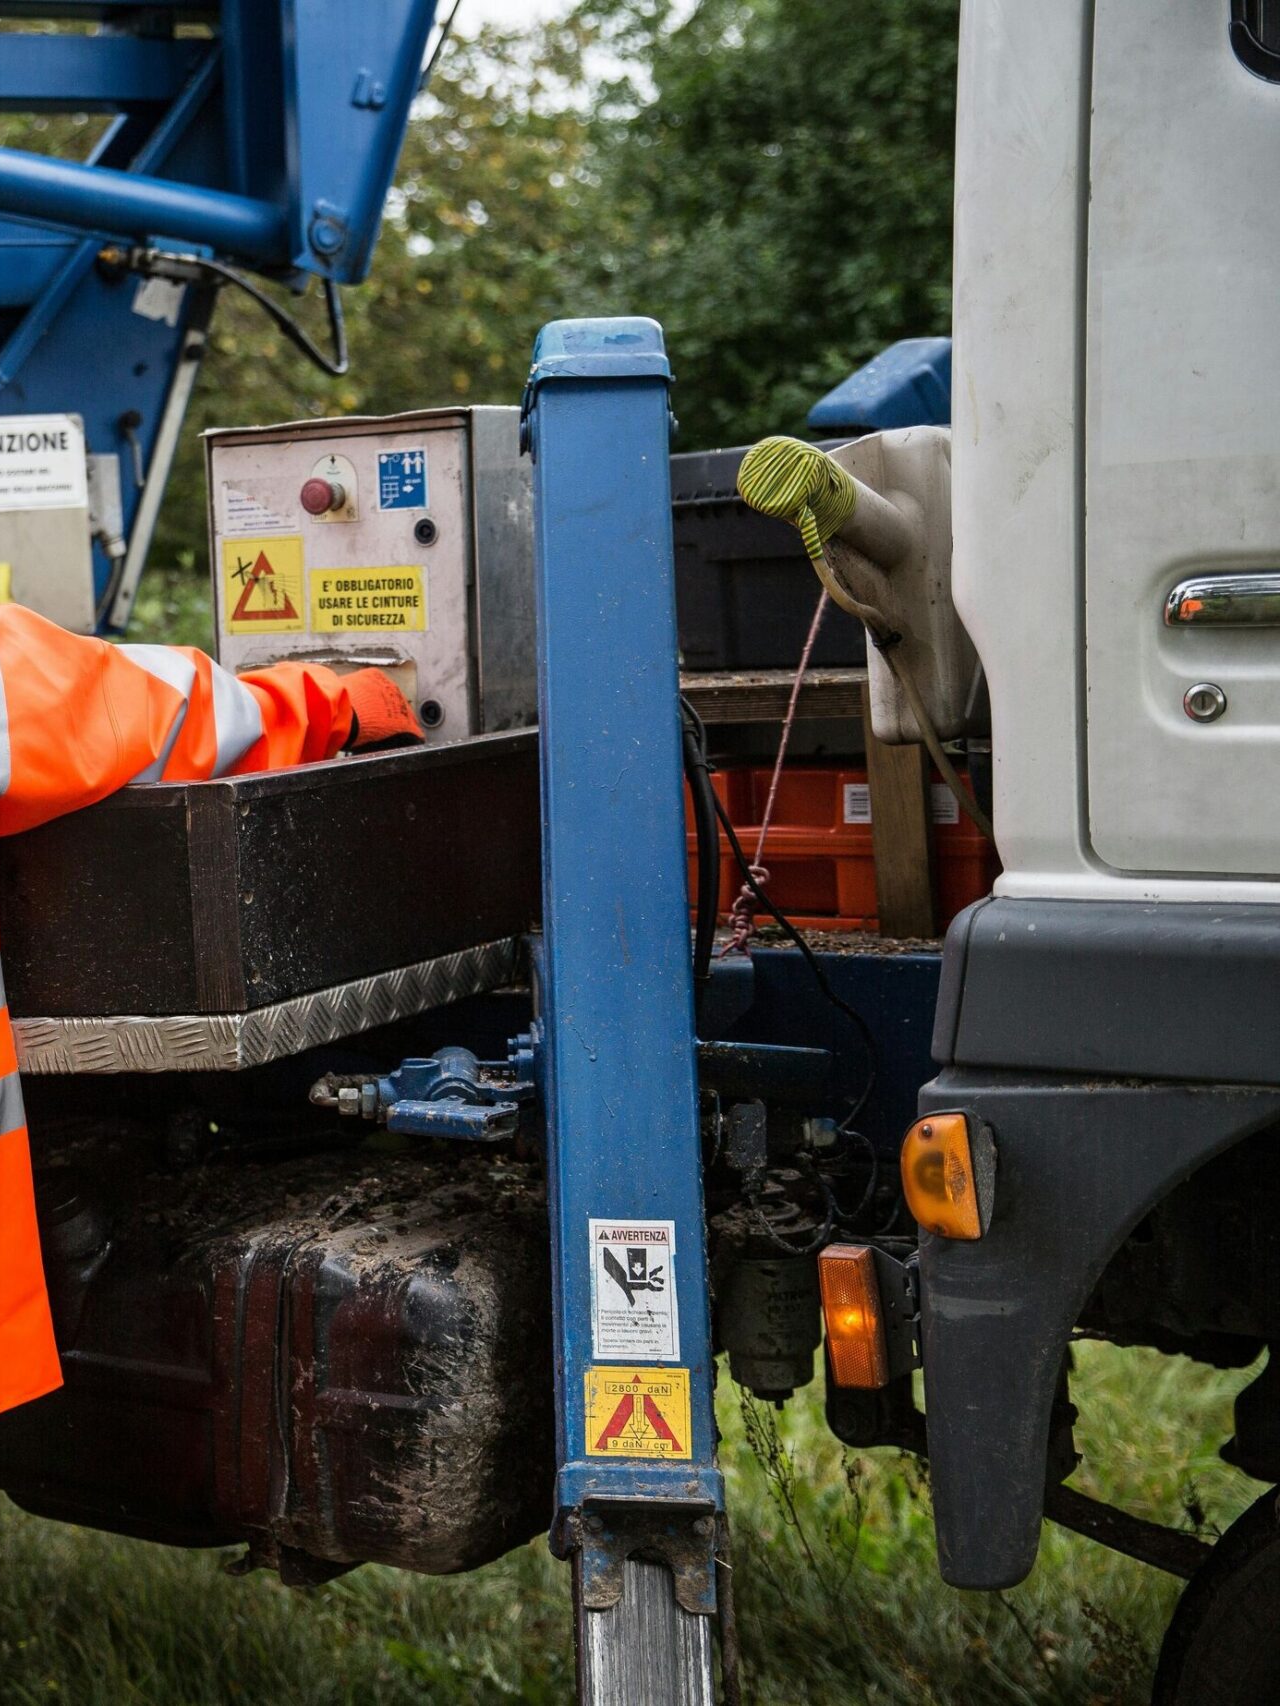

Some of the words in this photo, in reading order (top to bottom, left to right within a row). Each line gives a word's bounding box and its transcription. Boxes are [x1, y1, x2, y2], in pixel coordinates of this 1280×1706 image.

[322, 580, 333, 592] E'
[336, 577, 414, 592] OBBLIGATORIO
[318, 597, 353, 610] USARE
[356, 596, 369, 609] LE
[372, 595, 419, 609] CINTURE
[332, 614, 343, 627] DI
[346, 613, 406, 627] SICUREZZA
[611, 1229, 668, 1242] AVVERTENZA
[611, 1383, 639, 1393] 2800
[647, 1384, 668, 1394] daN
[611, 1439, 618, 1448] 9
[622, 1439, 643, 1448] daN
